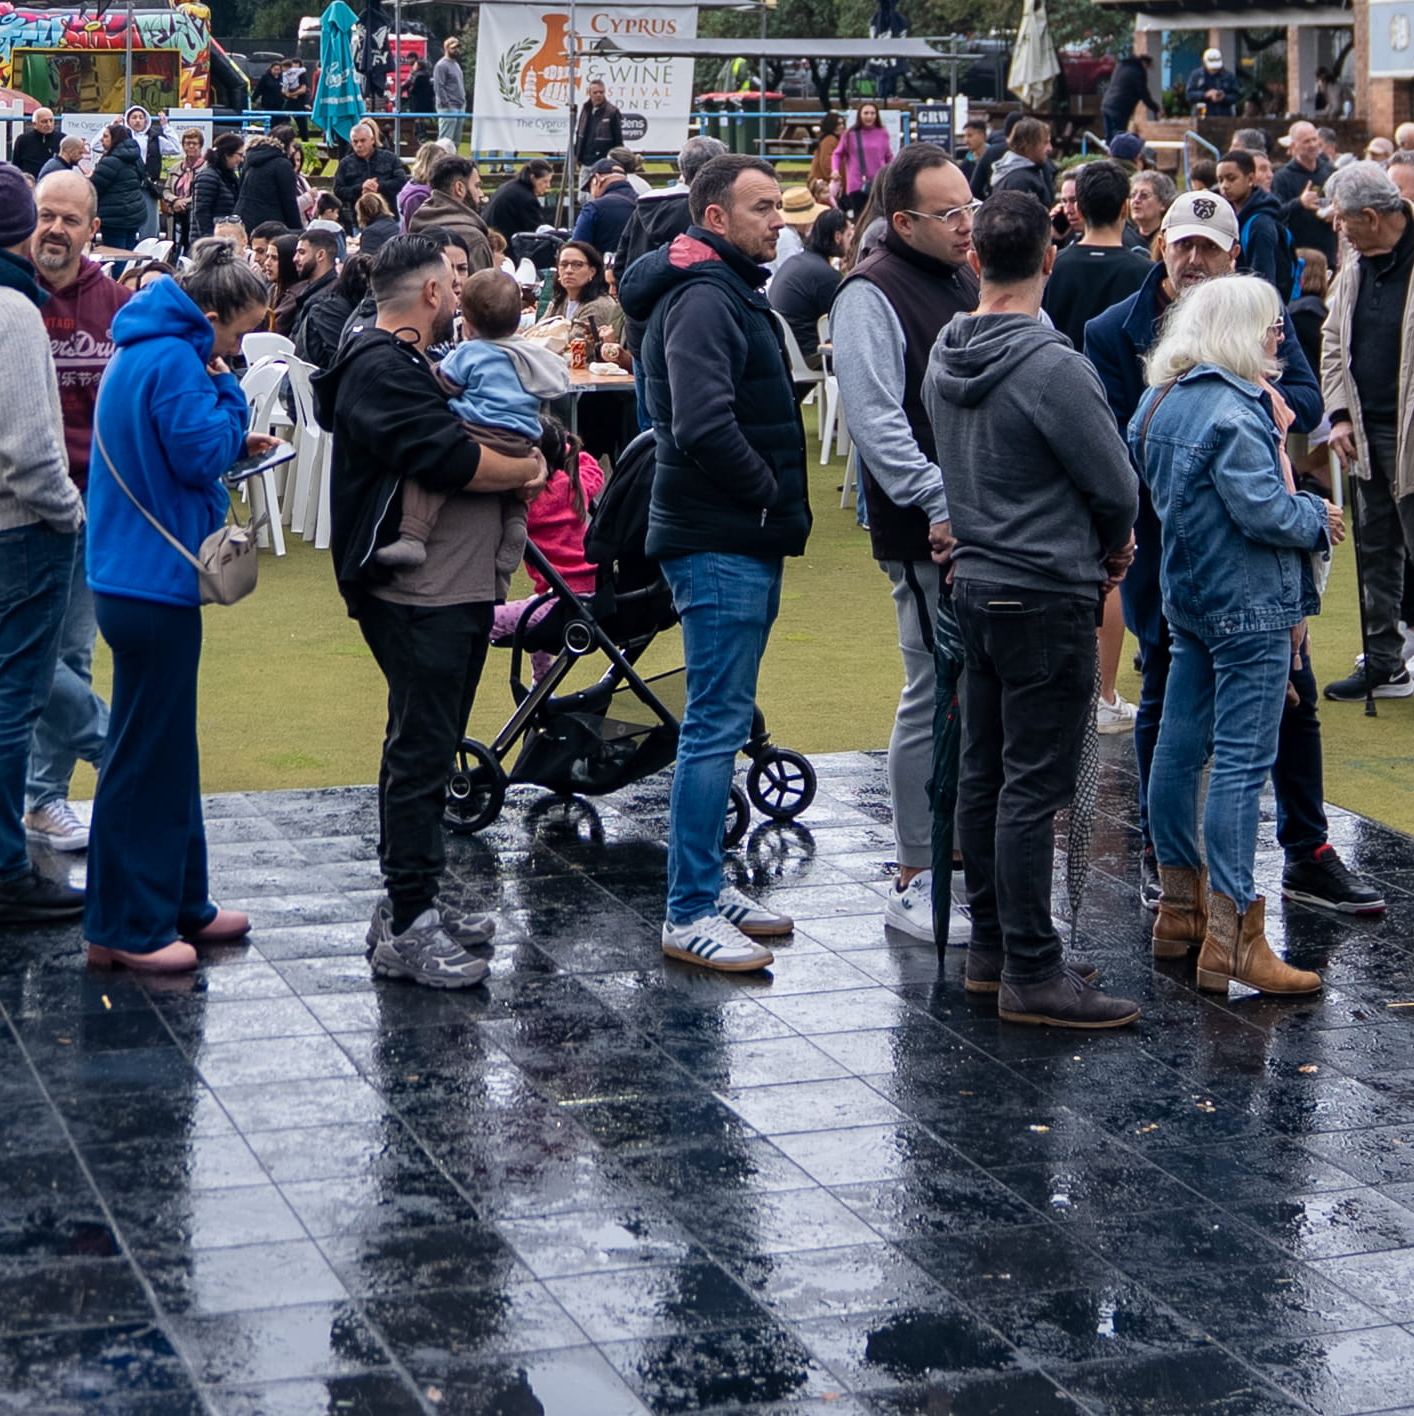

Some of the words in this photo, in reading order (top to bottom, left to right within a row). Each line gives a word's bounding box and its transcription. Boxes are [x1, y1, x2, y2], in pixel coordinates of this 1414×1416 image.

[590, 13, 677, 37] CYPRUS
[609, 65, 674, 84] WINE
[516, 118, 533, 128] The
[917, 110, 949, 123] GRW
